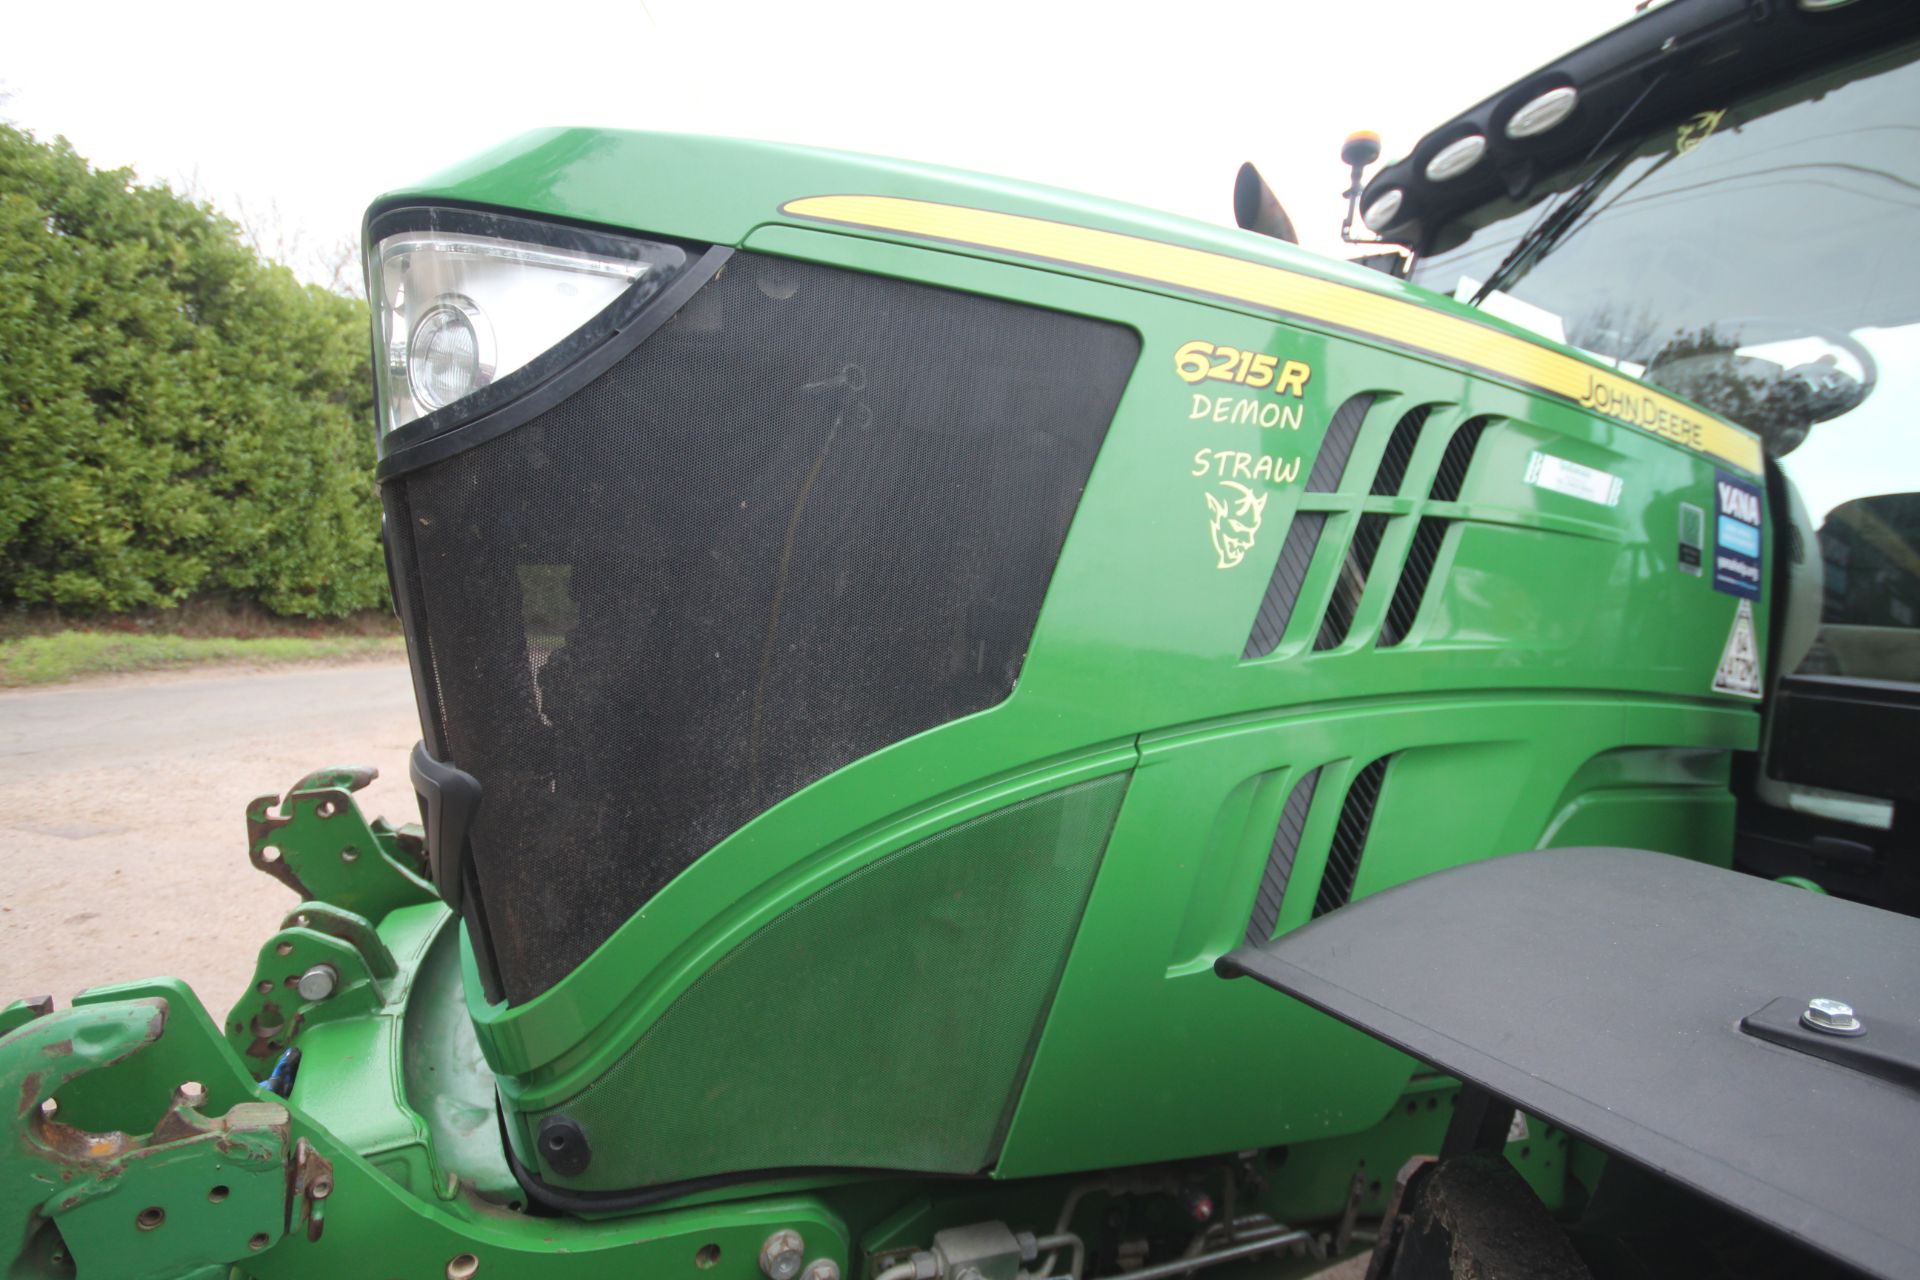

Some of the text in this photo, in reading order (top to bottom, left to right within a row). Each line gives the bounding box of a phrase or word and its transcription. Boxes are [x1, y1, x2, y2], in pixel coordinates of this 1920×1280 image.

[1174, 340, 1311, 398] 6215R
[1189, 393, 1304, 430] DEMON
[1578, 374, 1704, 450] JOHN DEERE
[1191, 448, 1301, 483] STRAW
